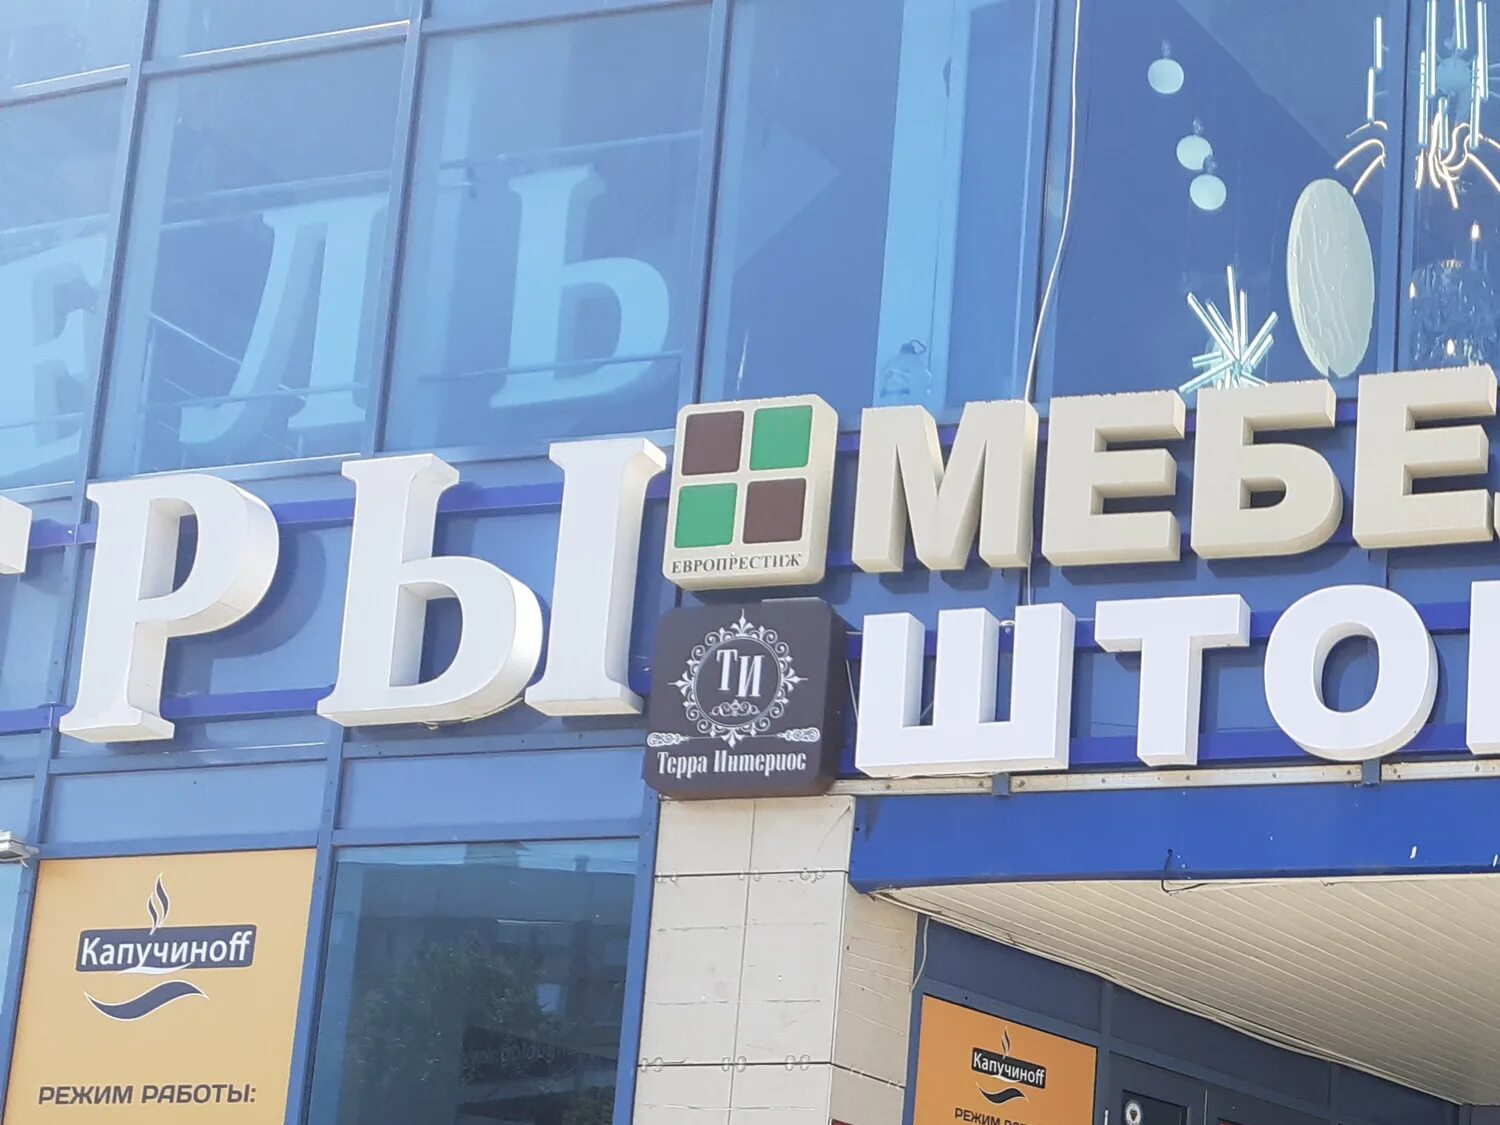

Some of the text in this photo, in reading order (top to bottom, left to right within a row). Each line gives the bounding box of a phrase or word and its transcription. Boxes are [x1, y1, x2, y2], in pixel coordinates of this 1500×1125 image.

[672, 553, 802, 574] ЕВРОПРЕСТИЖ
[0, 437, 667, 743] РЫ
[716, 649, 763, 697] ТИ
[657, 752, 707, 778] Терра
[81, 931, 252, 968] Капучиноff
[39, 1084, 257, 1105] РЕЖИМ РАБОТЫ:
